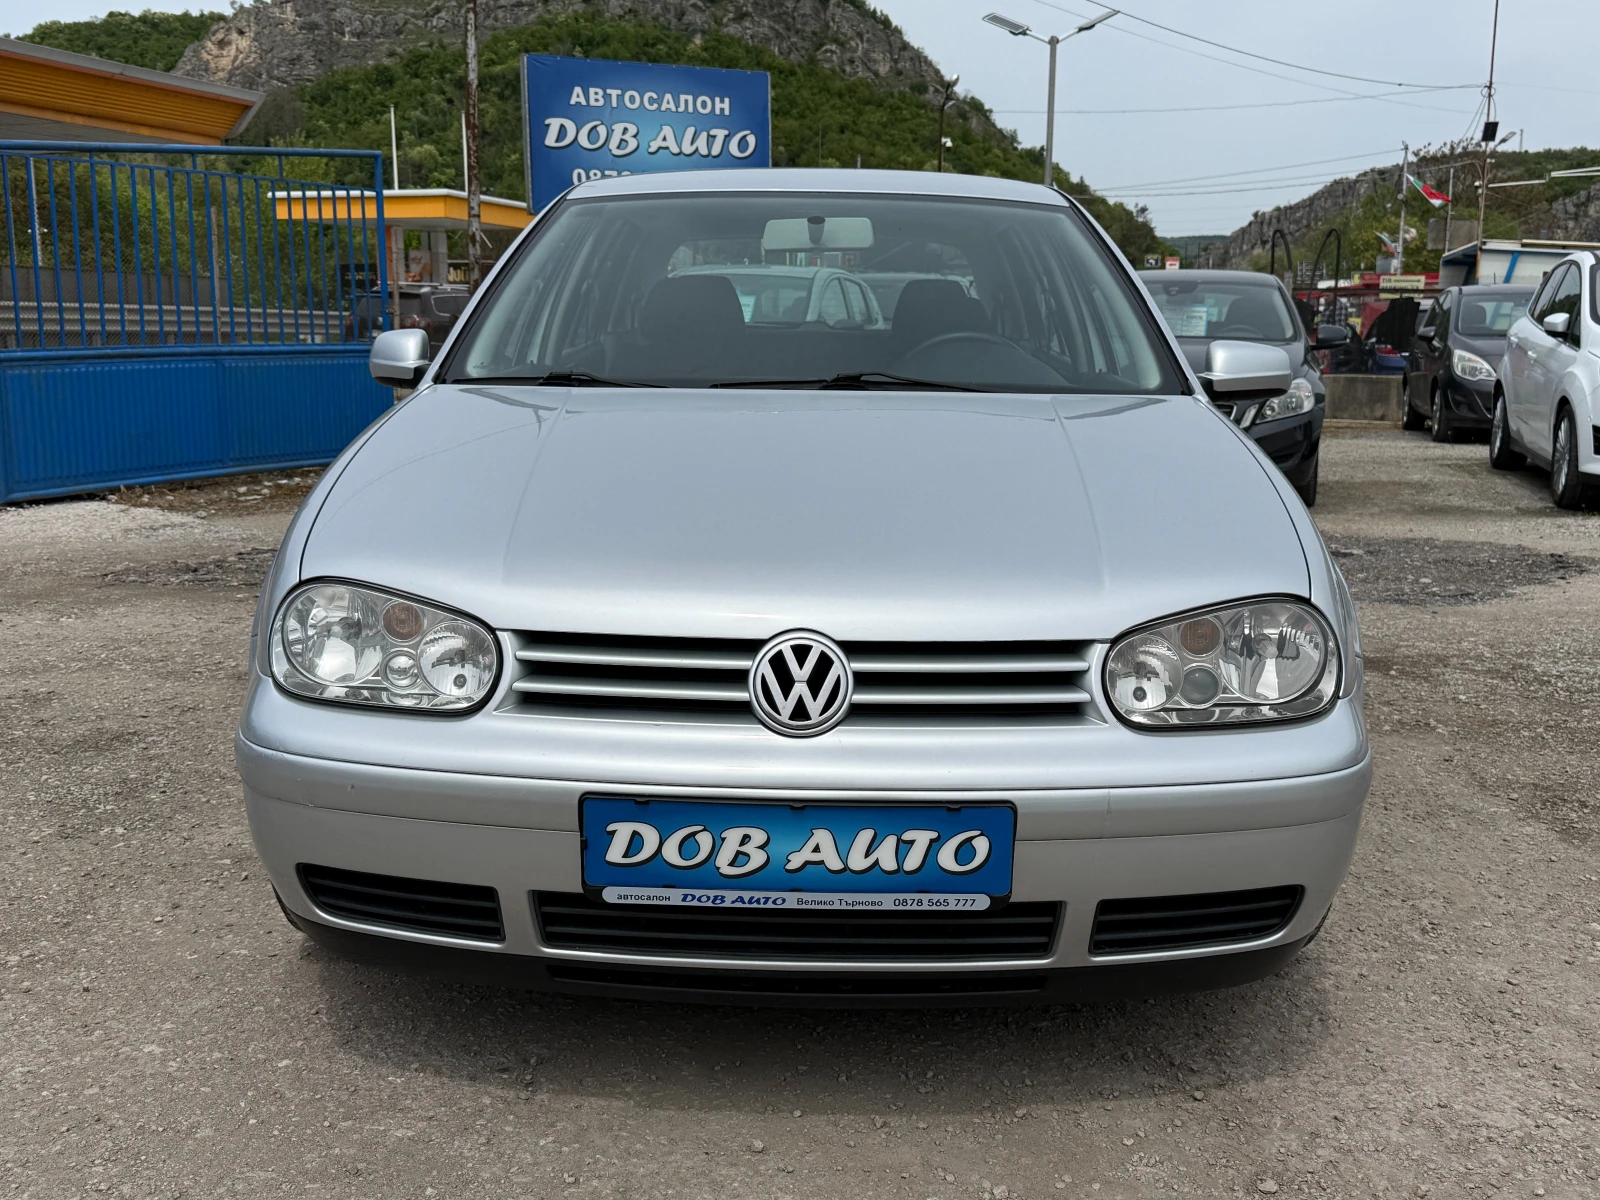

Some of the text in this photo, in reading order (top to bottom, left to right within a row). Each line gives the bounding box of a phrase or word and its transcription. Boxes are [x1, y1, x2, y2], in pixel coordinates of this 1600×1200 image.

[569, 86, 731, 116] АВТОСАЛОН
[543, 117, 757, 159] DOB AUTO
[604, 821, 991, 878] DOB AUTO
[616, 892, 977, 908] автосалон DOB AUTO Велико Търново 0878 565 777
